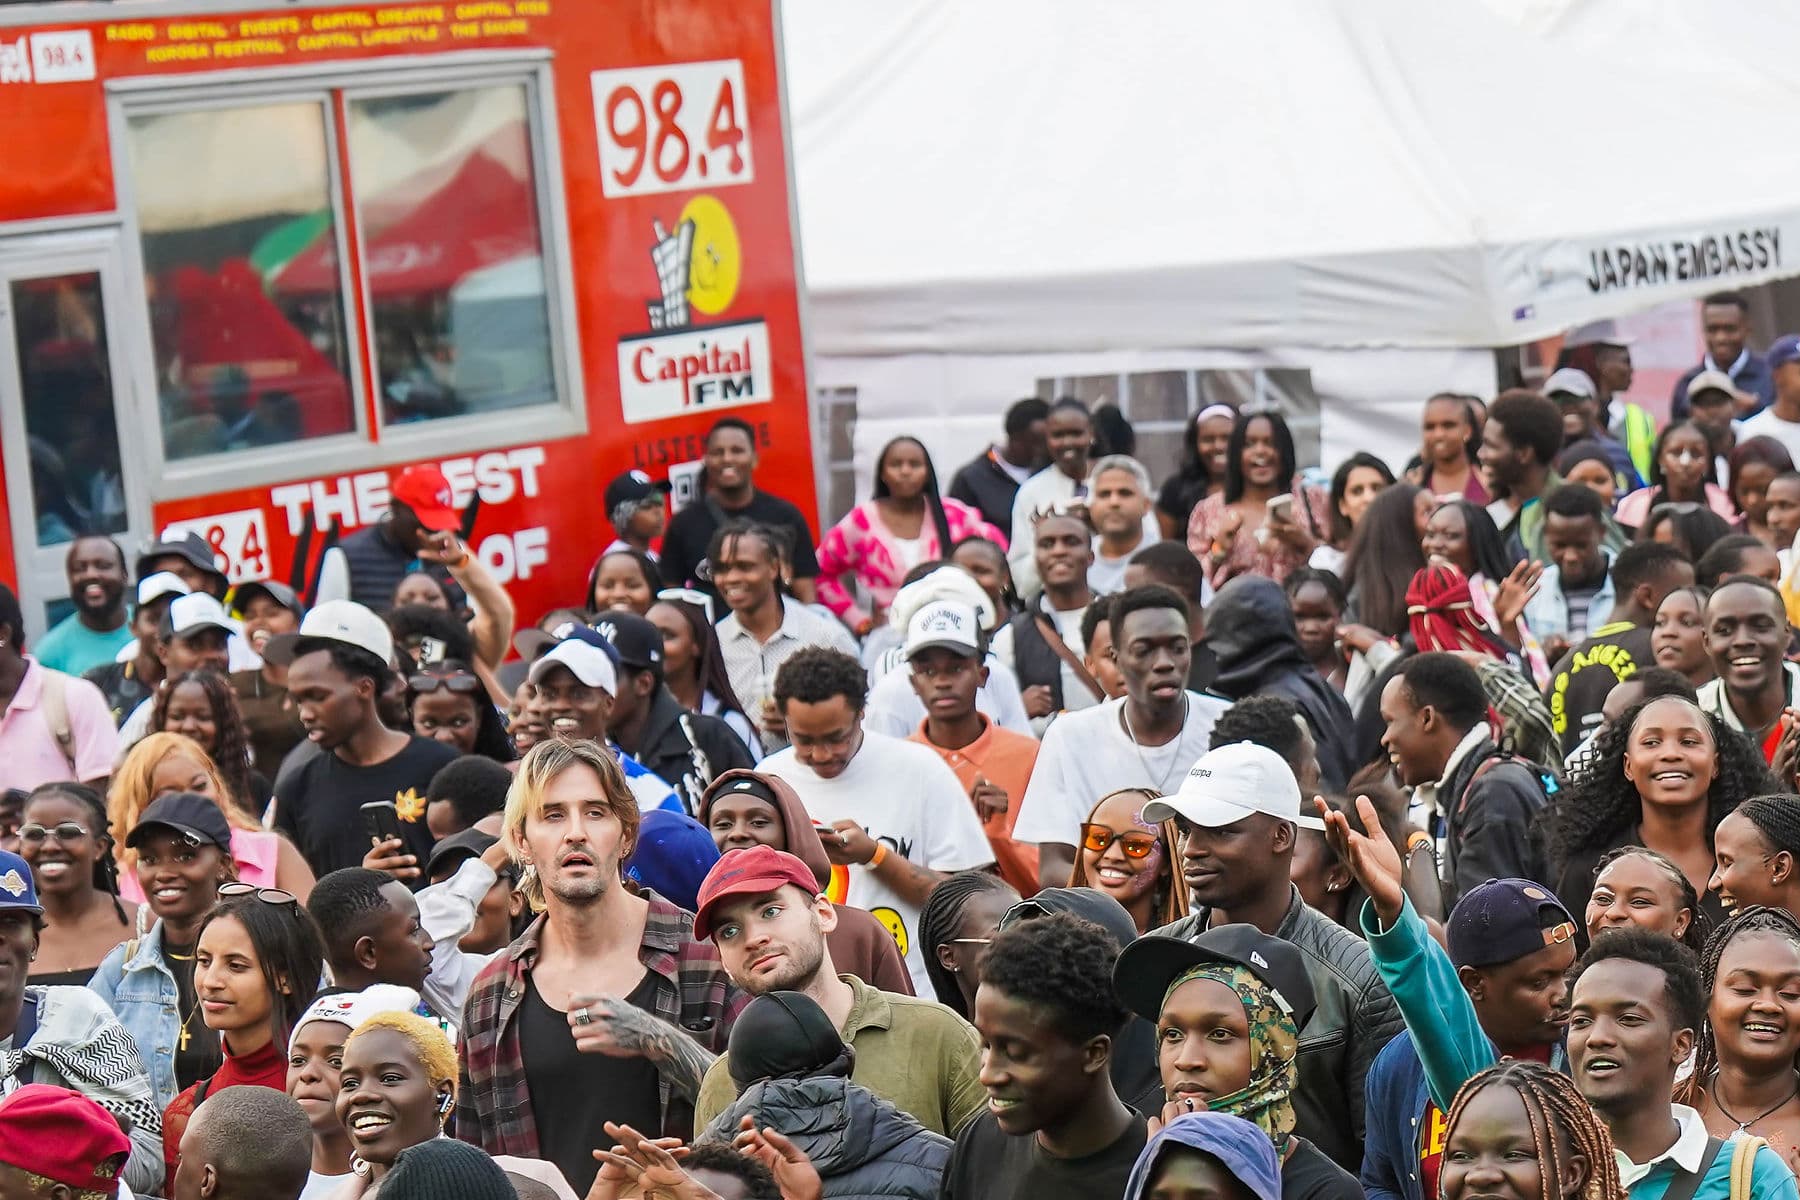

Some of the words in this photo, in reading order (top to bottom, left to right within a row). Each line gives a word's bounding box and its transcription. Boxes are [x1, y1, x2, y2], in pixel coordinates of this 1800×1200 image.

[106, 24, 155, 41] RADIO
[605, 78, 744, 187] 98.4
[1586, 240, 1672, 294] JAPAN
[1674, 226, 1783, 280] EMBASSY
[632, 337, 753, 406] Capital
[693, 374, 755, 405] FM
[634, 433, 708, 467] LISTE
[271, 472, 390, 535] THE
[477, 527, 549, 585] OF
